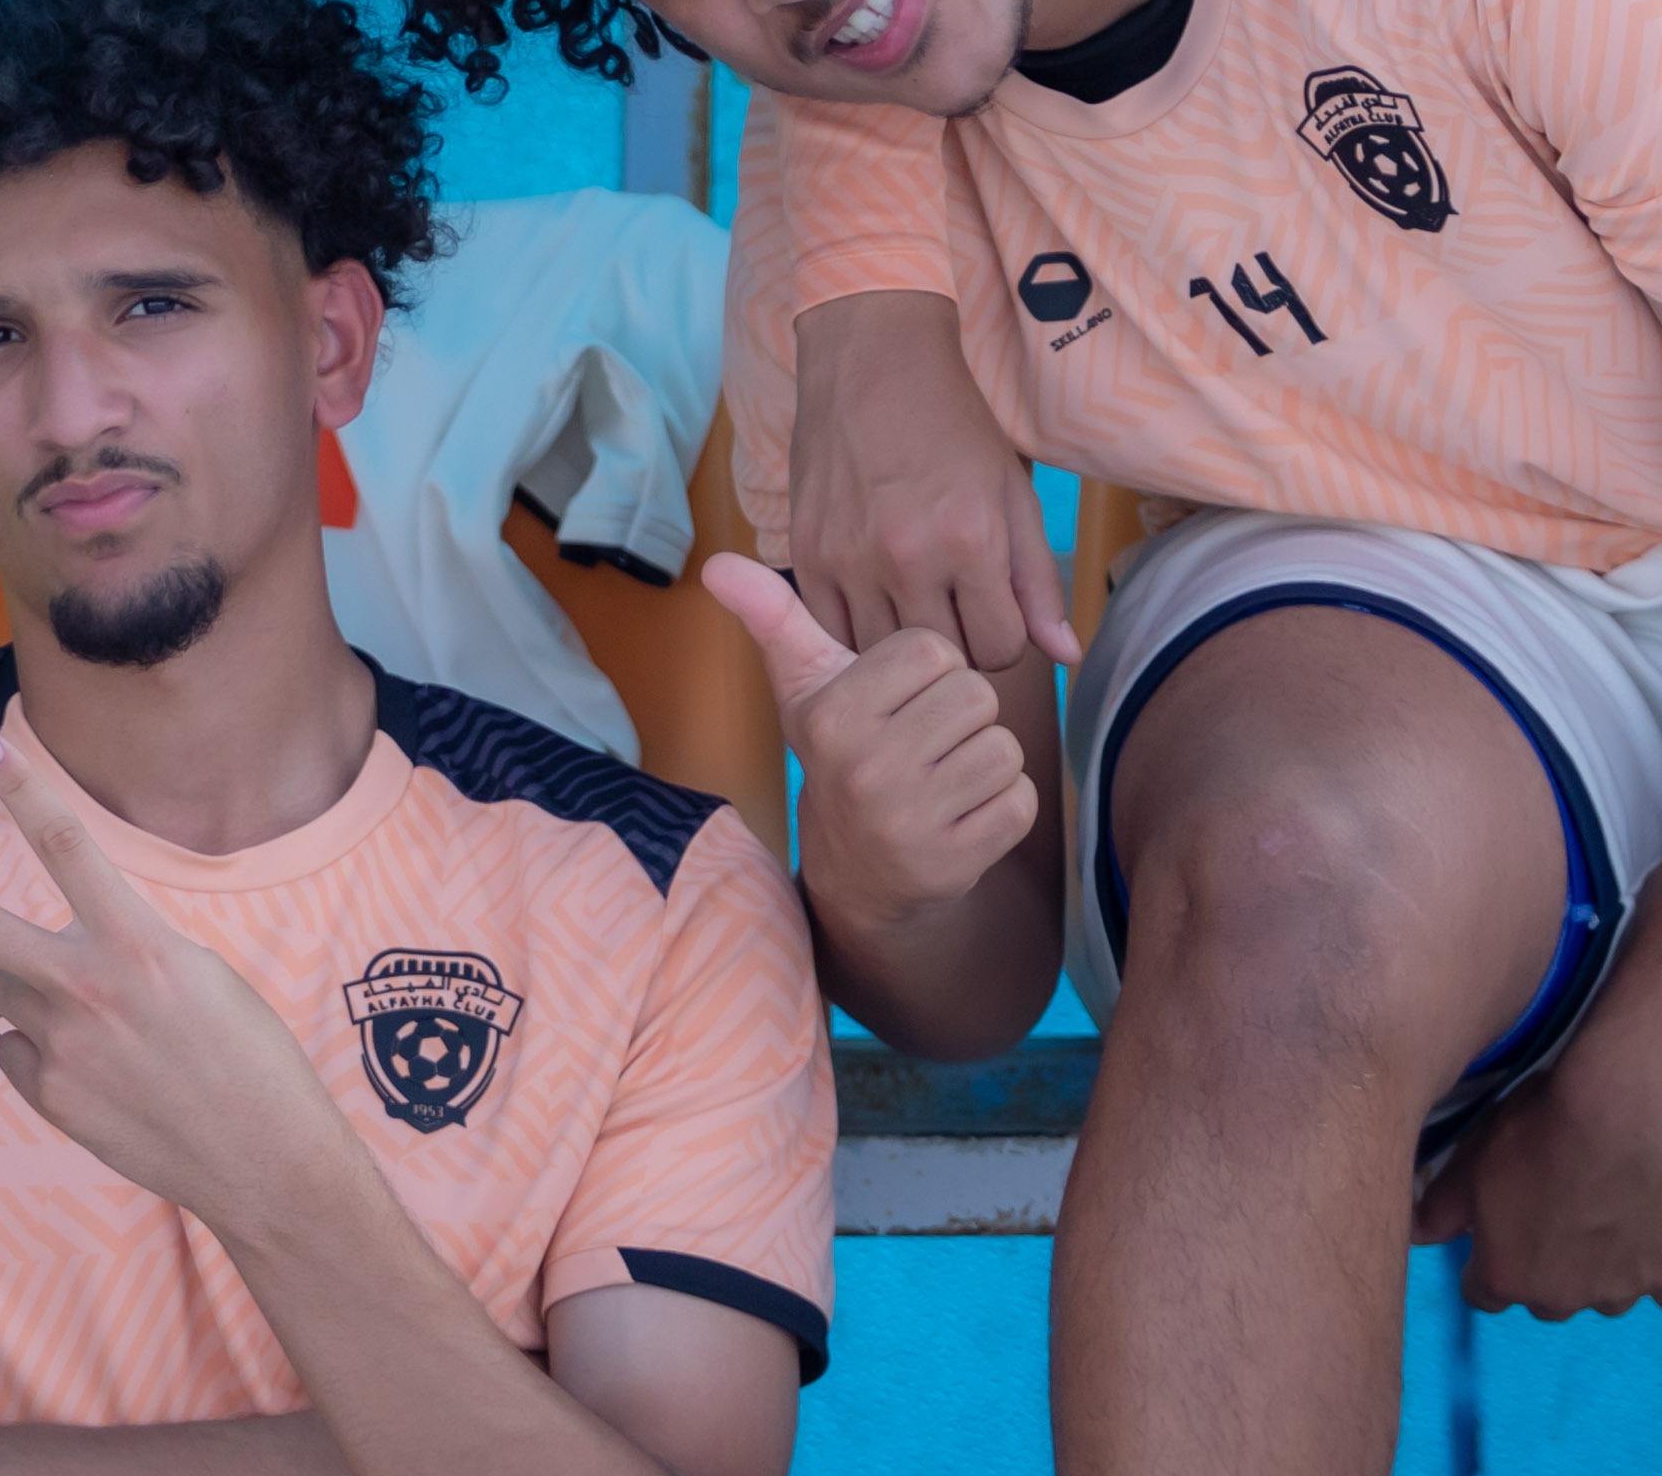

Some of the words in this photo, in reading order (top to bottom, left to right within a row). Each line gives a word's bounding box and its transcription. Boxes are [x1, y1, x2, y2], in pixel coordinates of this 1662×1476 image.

[1188, 250, 1329, 357] 14
[1050, 307, 1112, 352] SKILLANO
[368, 995, 446, 1014] ALFAYHA
[453, 998, 497, 1021] CLUB
[413, 1103, 444, 1118] 1953
